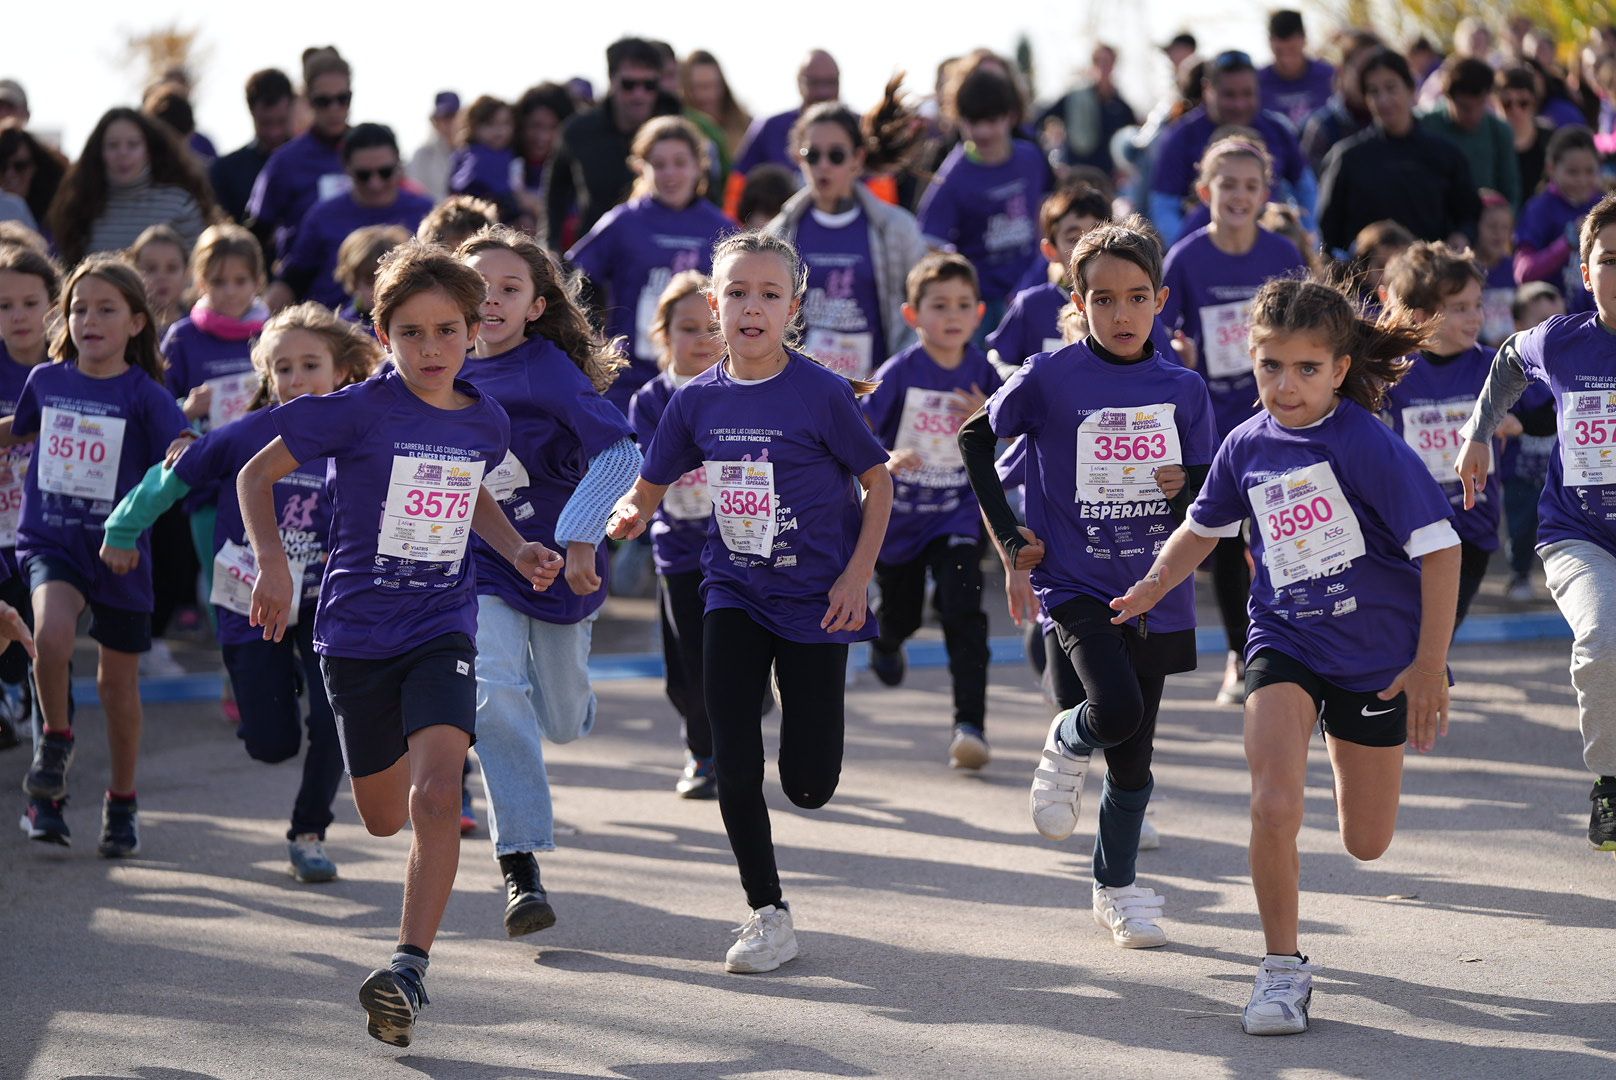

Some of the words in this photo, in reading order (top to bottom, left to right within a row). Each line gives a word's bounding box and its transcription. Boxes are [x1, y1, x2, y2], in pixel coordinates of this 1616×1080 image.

[1135, 412, 1144, 421] 10
[745, 428, 764, 436] CIUDADES
[1133, 423, 1161, 431] ESPERANZA
[726, 434, 741, 442] CÁNCER
[747, 434, 771, 443] PÁNCREAS
[48, 435, 106, 464] 3510
[401, 443, 424, 451] CARRERA
[433, 445, 443, 453] LAS
[444, 446, 467, 456] CIUDADES
[1094, 433, 1167, 461] 3563
[417, 452, 438, 460] CÁNCER
[450, 467, 460, 477] 10
[404, 489, 471, 519] 3575
[720, 489, 771, 517] 3584
[777, 507, 791, 515] POR
[1268, 496, 1333, 541] 3590
